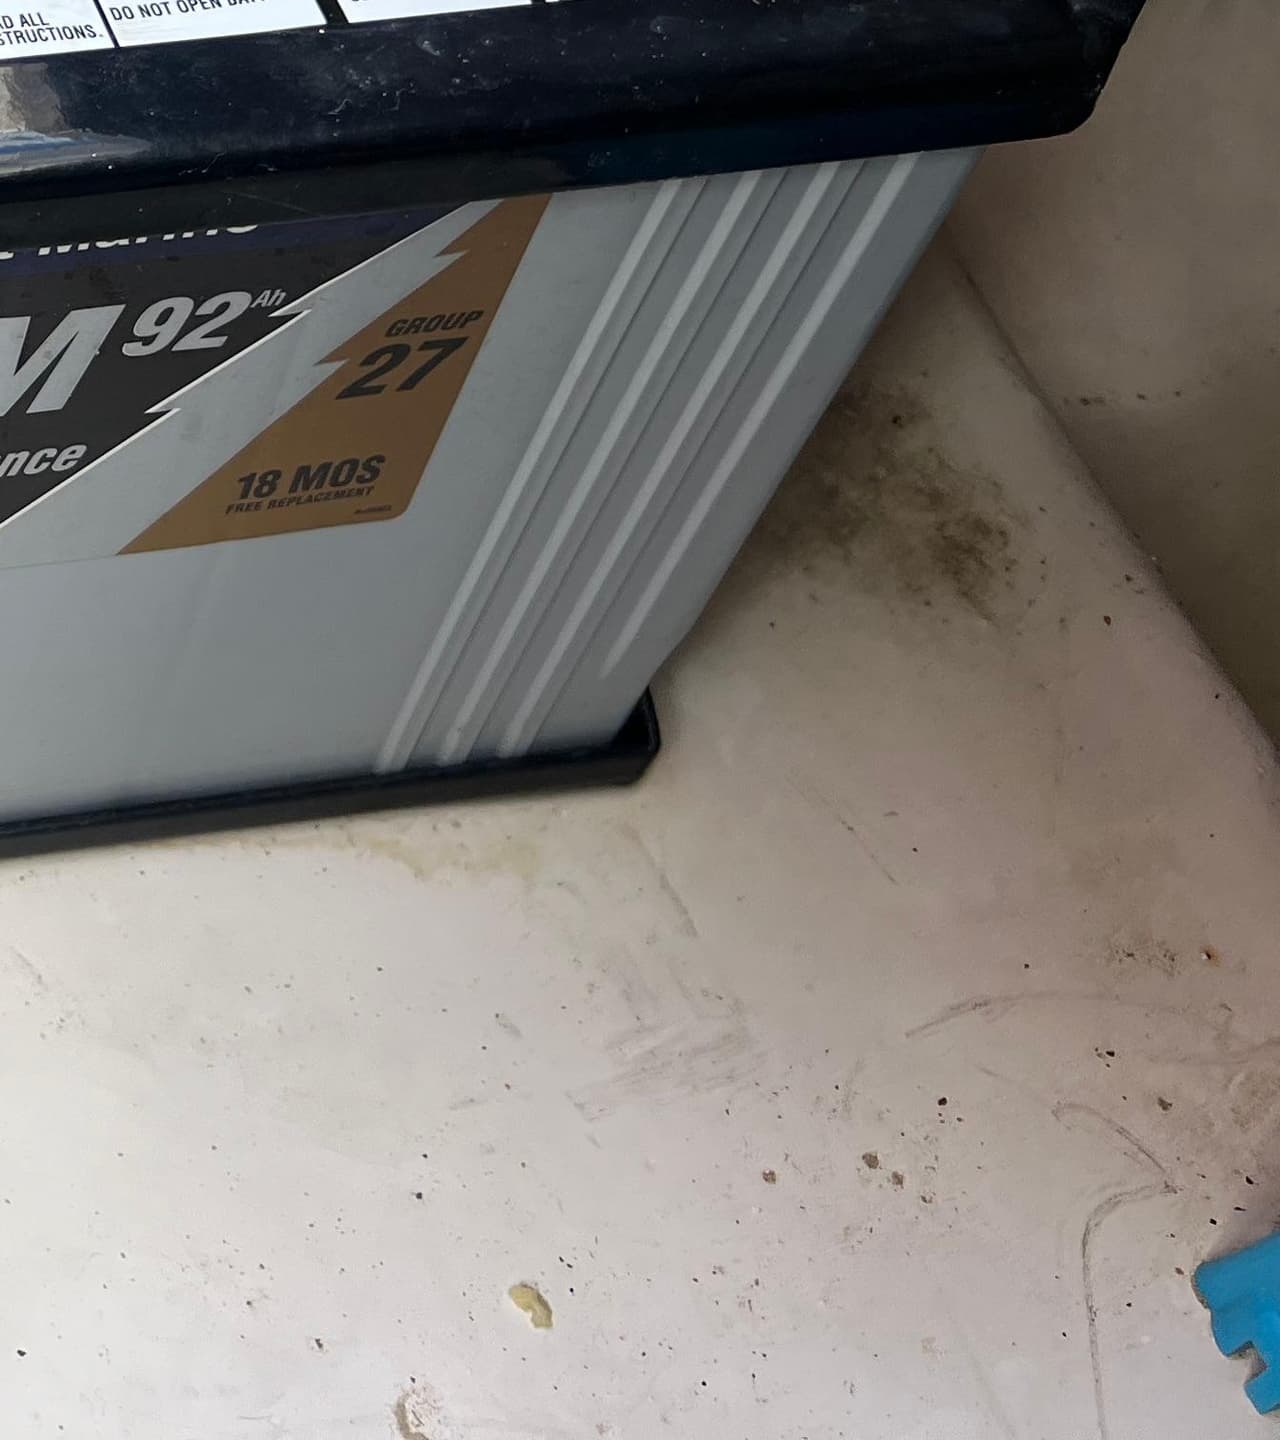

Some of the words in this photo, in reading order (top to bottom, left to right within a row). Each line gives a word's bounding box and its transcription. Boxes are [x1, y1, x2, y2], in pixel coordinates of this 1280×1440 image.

[20, 12, 50, 27] ALL
[109, 6, 135, 21] DO
[140, 1, 172, 19] NOT
[121, 290, 255, 357] 92
[251, 288, 287, 308] Ah
[384, 310, 484, 338] GROUP
[334, 336, 469, 400] 27
[238, 469, 282, 499] 18
[288, 454, 386, 494] MOS
[225, 500, 262, 515] FREE
[268, 486, 375, 509] REPLACEMENT
